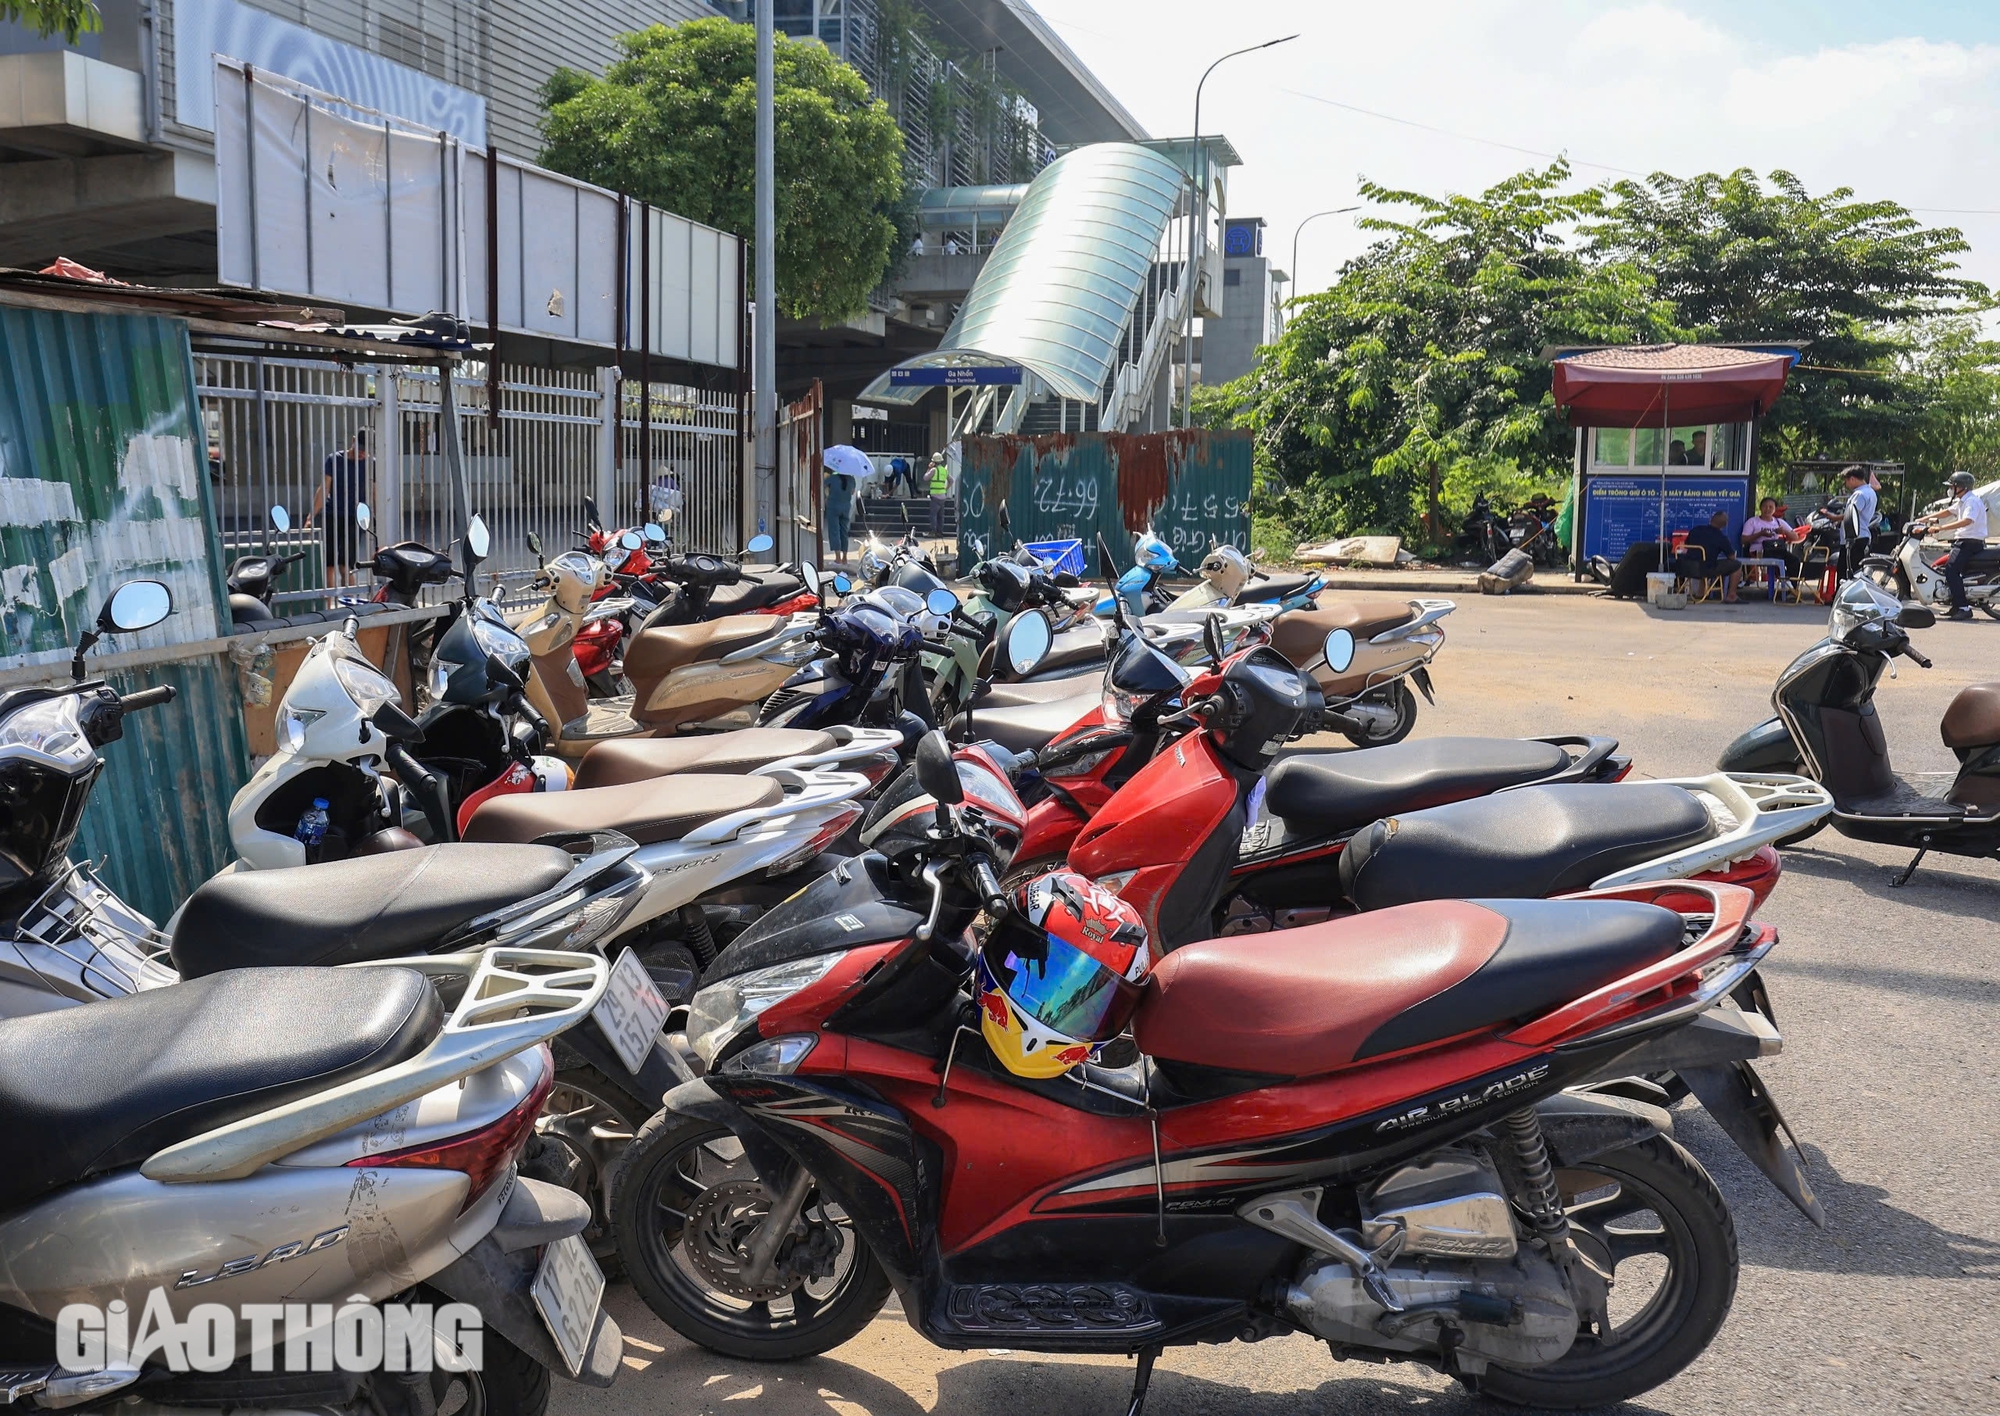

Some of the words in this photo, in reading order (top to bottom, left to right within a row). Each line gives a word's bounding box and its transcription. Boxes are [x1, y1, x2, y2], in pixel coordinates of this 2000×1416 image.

[1081, 926, 1105, 944] Royal
[1375, 1105, 1431, 1133] AIR
[1438, 1064, 1549, 1112] BLADE
[1400, 1112, 1449, 1130] PREMIUM
[1454, 1097, 1490, 1113] SPORT
[1496, 1080, 1539, 1099] EDITION
[173, 1224, 350, 1291] LEAD
